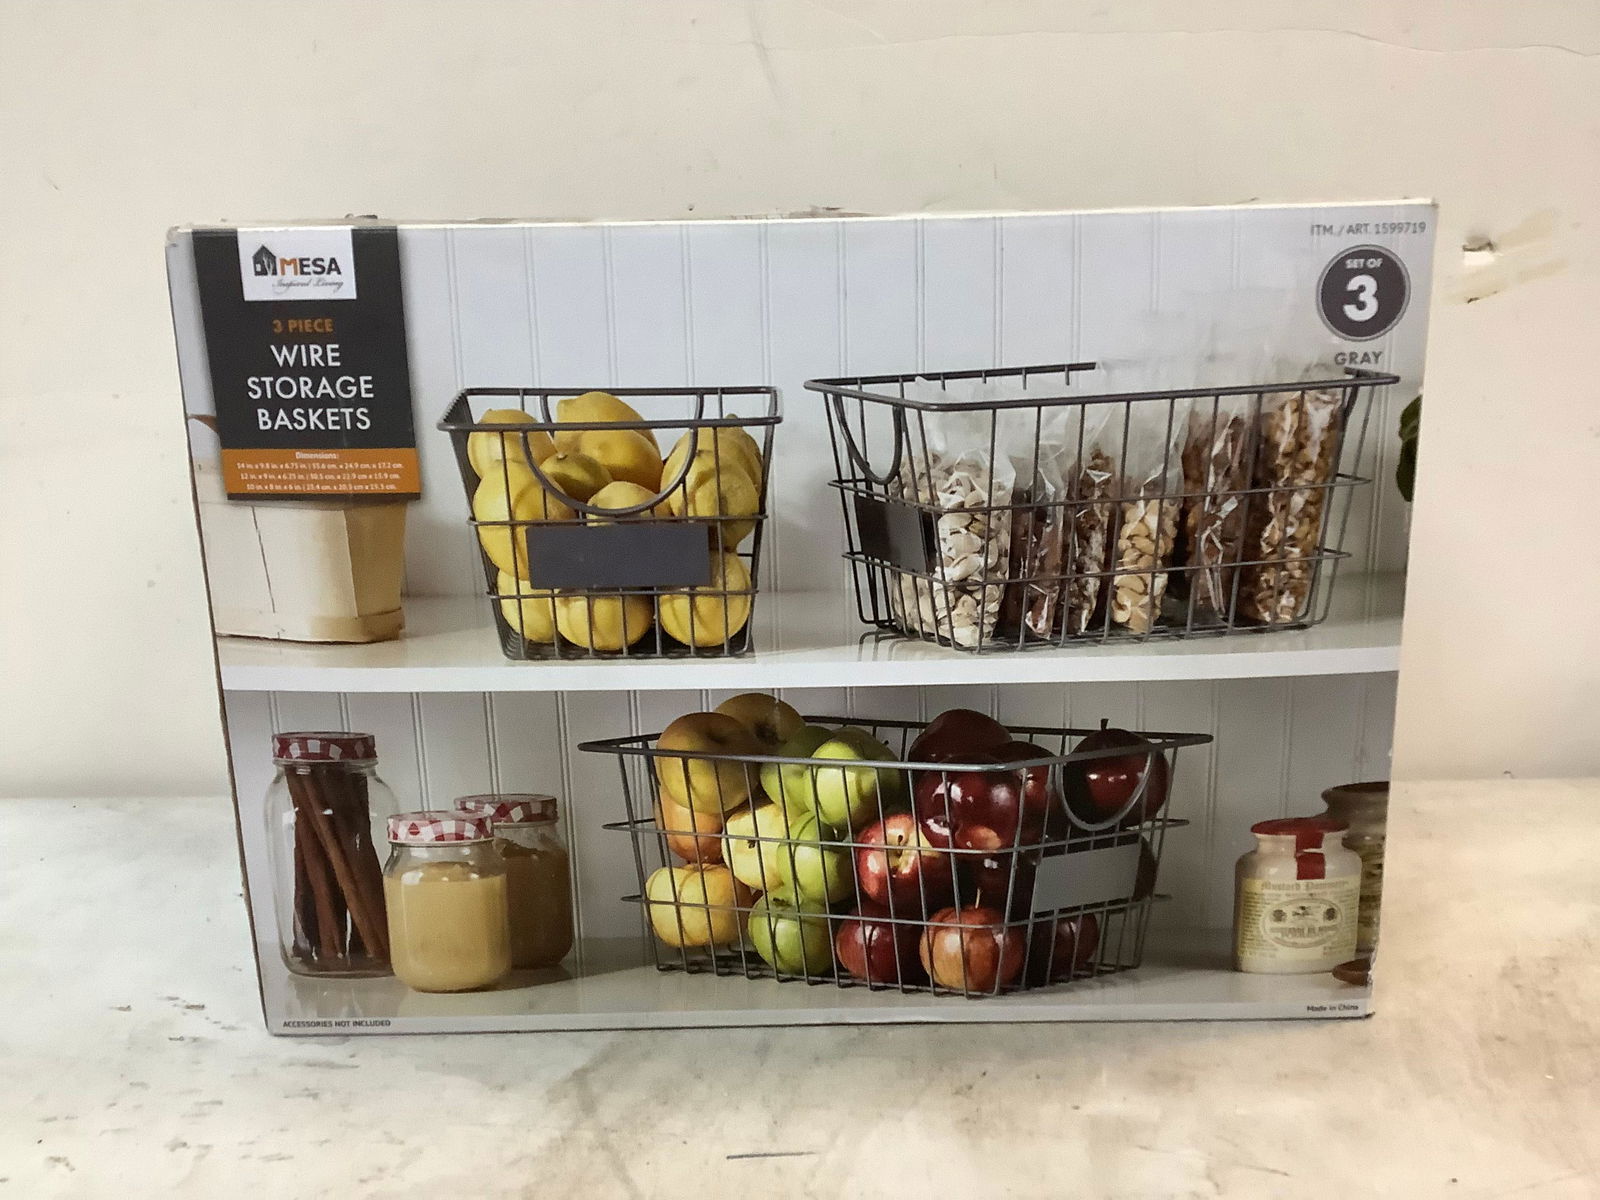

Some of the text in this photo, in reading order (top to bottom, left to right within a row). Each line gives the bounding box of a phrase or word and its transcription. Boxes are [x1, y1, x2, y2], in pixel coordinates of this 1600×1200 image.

[1374, 221, 1427, 234] 1599719
[280, 257, 342, 276] MESA
[1345, 257, 1383, 269] SET OF
[1343, 274, 1379, 322] 3
[272, 318, 334, 332] 3 PIECE
[270, 344, 341, 367] WIRE
[1334, 351, 1382, 365] GRAY
[247, 376, 374, 399] STORAGE
[257, 407, 371, 430] BASKETS
[1338, 1003, 1359, 1011] China
[283, 1020, 333, 1028] ACCESSORIES
[352, 1019, 391, 1027] INCLUDED
